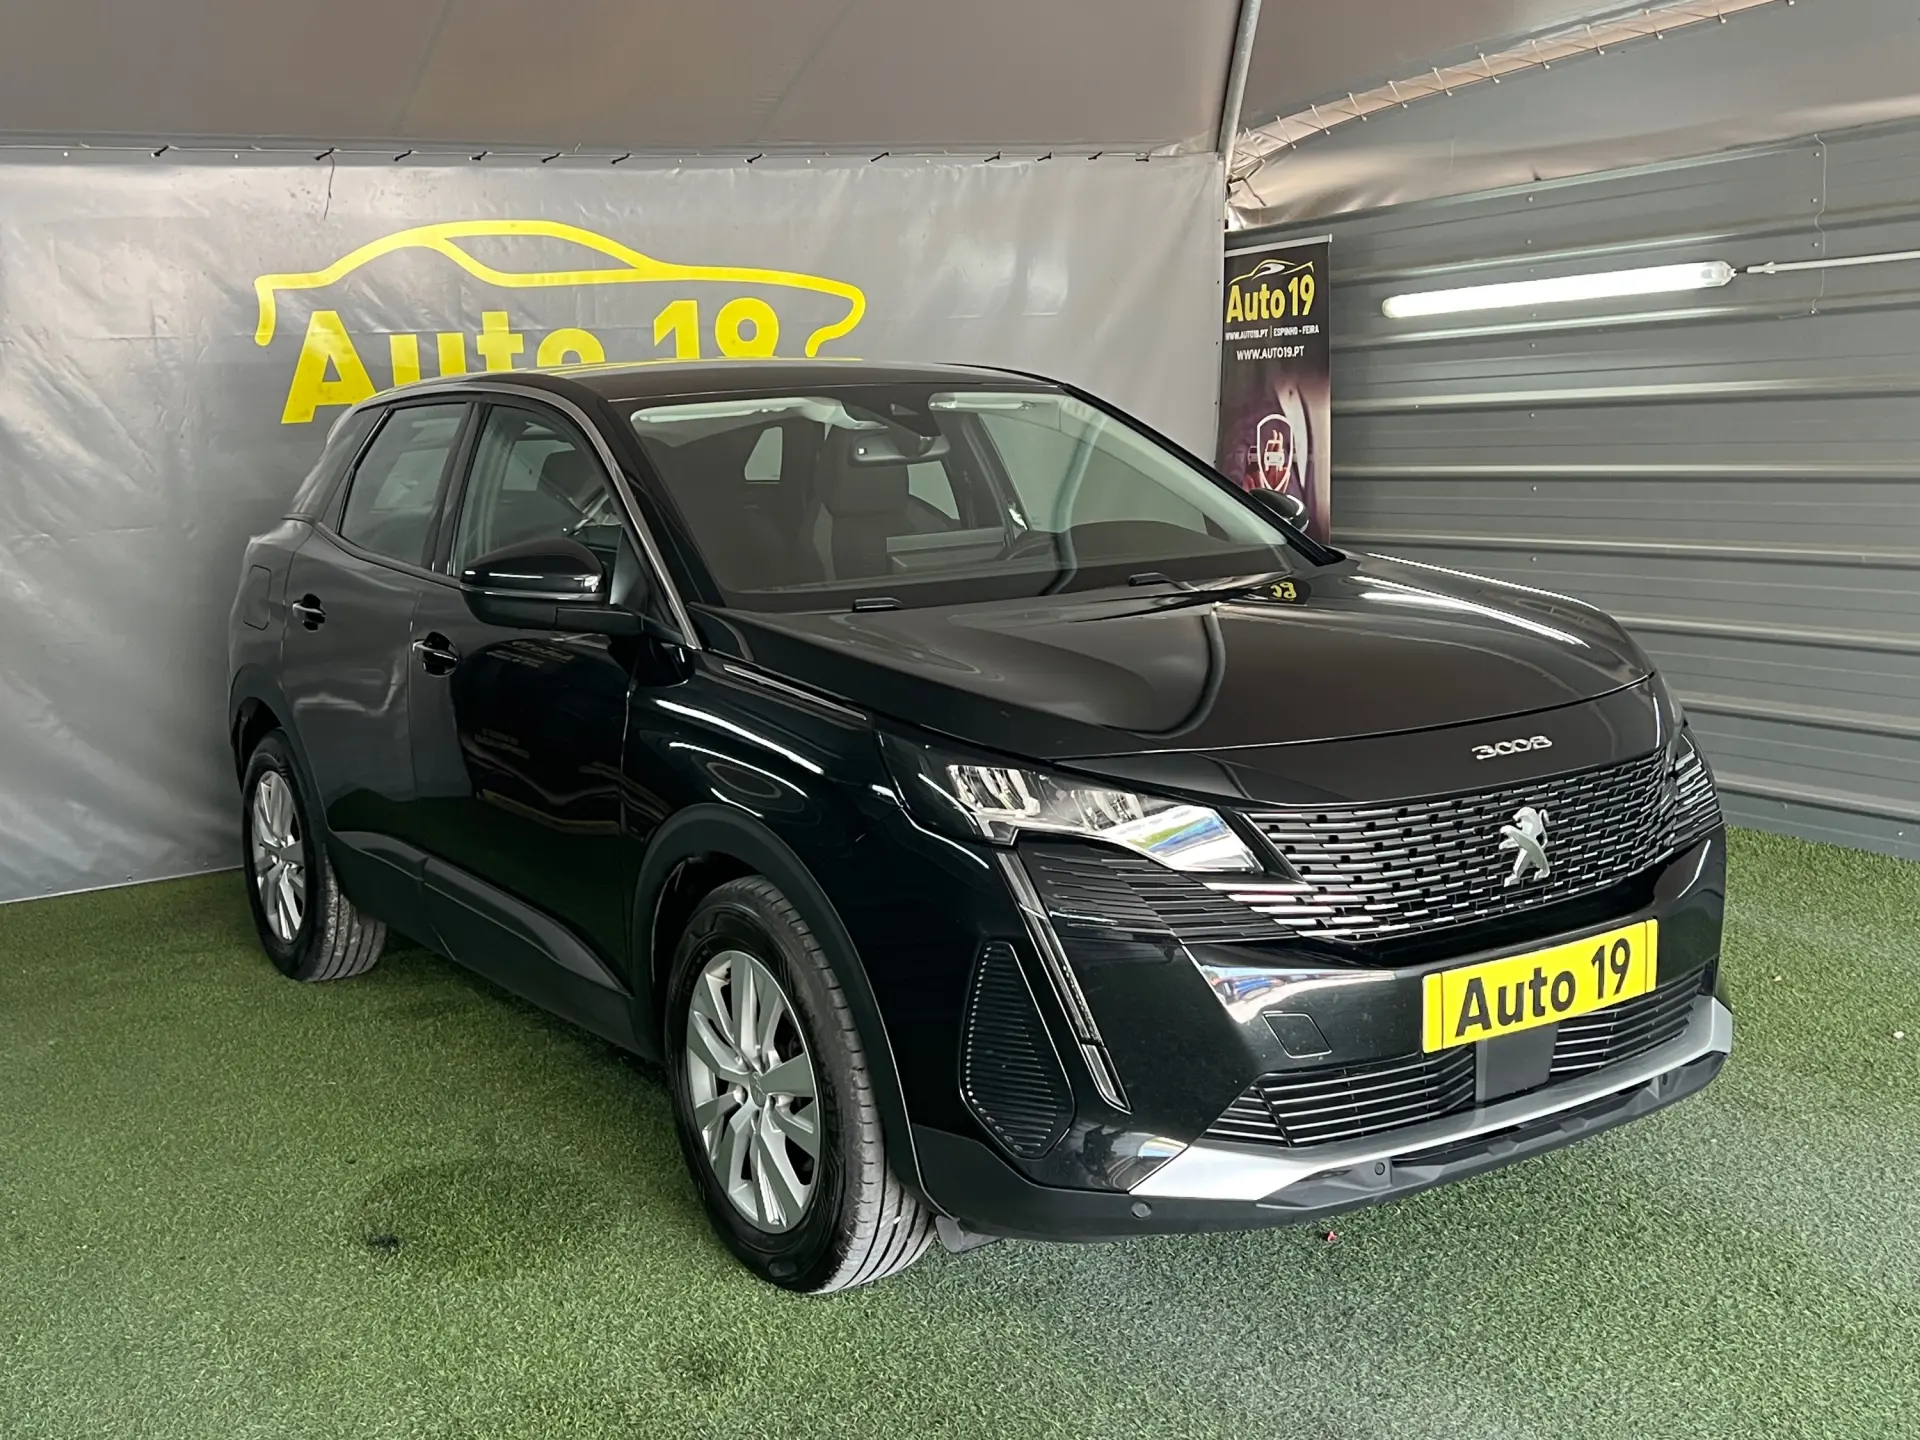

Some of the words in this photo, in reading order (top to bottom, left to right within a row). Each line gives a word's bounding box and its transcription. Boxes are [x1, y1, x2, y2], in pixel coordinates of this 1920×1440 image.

[1226, 283, 1285, 323] Auto
[1288, 274, 1315, 316] 19
[1302, 324, 1319, 334] FEIRA
[1236, 345, 1304, 360] WWW.AUTO19.PT
[1471, 735, 1553, 760] 3008
[1455, 966, 1577, 1039] Auto
[1590, 937, 1632, 1000] 19
